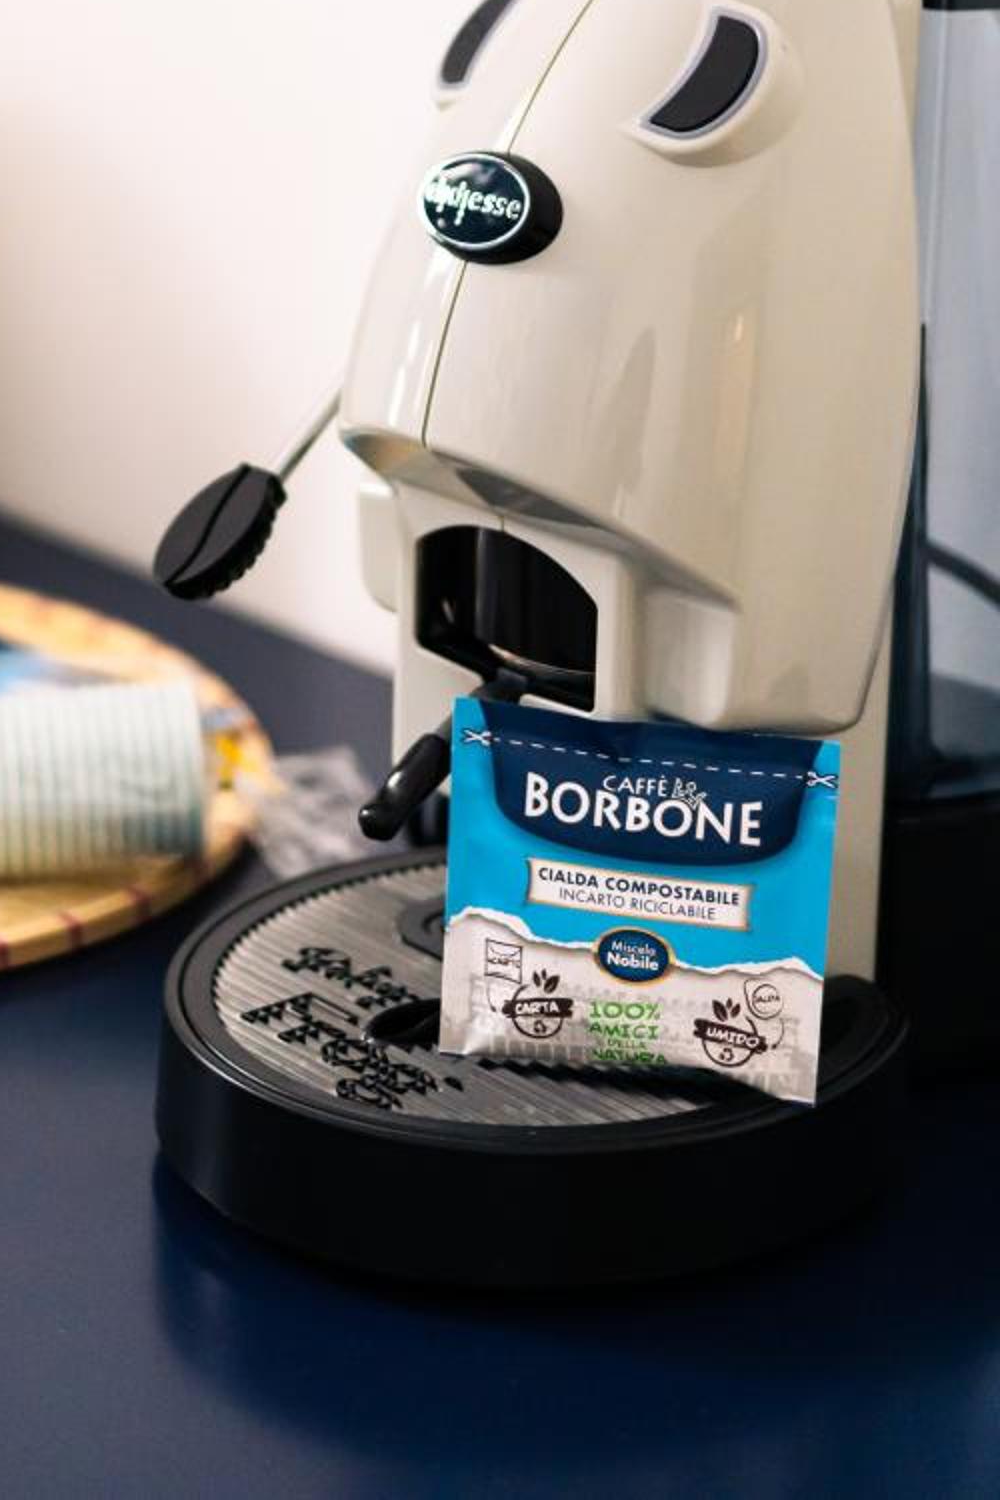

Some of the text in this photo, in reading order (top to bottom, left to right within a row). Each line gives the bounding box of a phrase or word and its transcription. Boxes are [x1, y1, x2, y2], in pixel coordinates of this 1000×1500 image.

[602, 774, 669, 798] CAFFÈ
[524, 771, 763, 847] BORBONE
[538, 866, 740, 906] CIALDA COMPOSTABILE
[559, 887, 716, 920] INCARTO RICICLABILE
[611, 940, 657, 957] Miscela
[606, 951, 660, 971] Nobile
[515, 1000, 562, 1015] CARTA
[588, 1001, 661, 1020] 100%
[588, 1022, 659, 1040] AMICI
[706, 1026, 759, 1048] UMIDO
